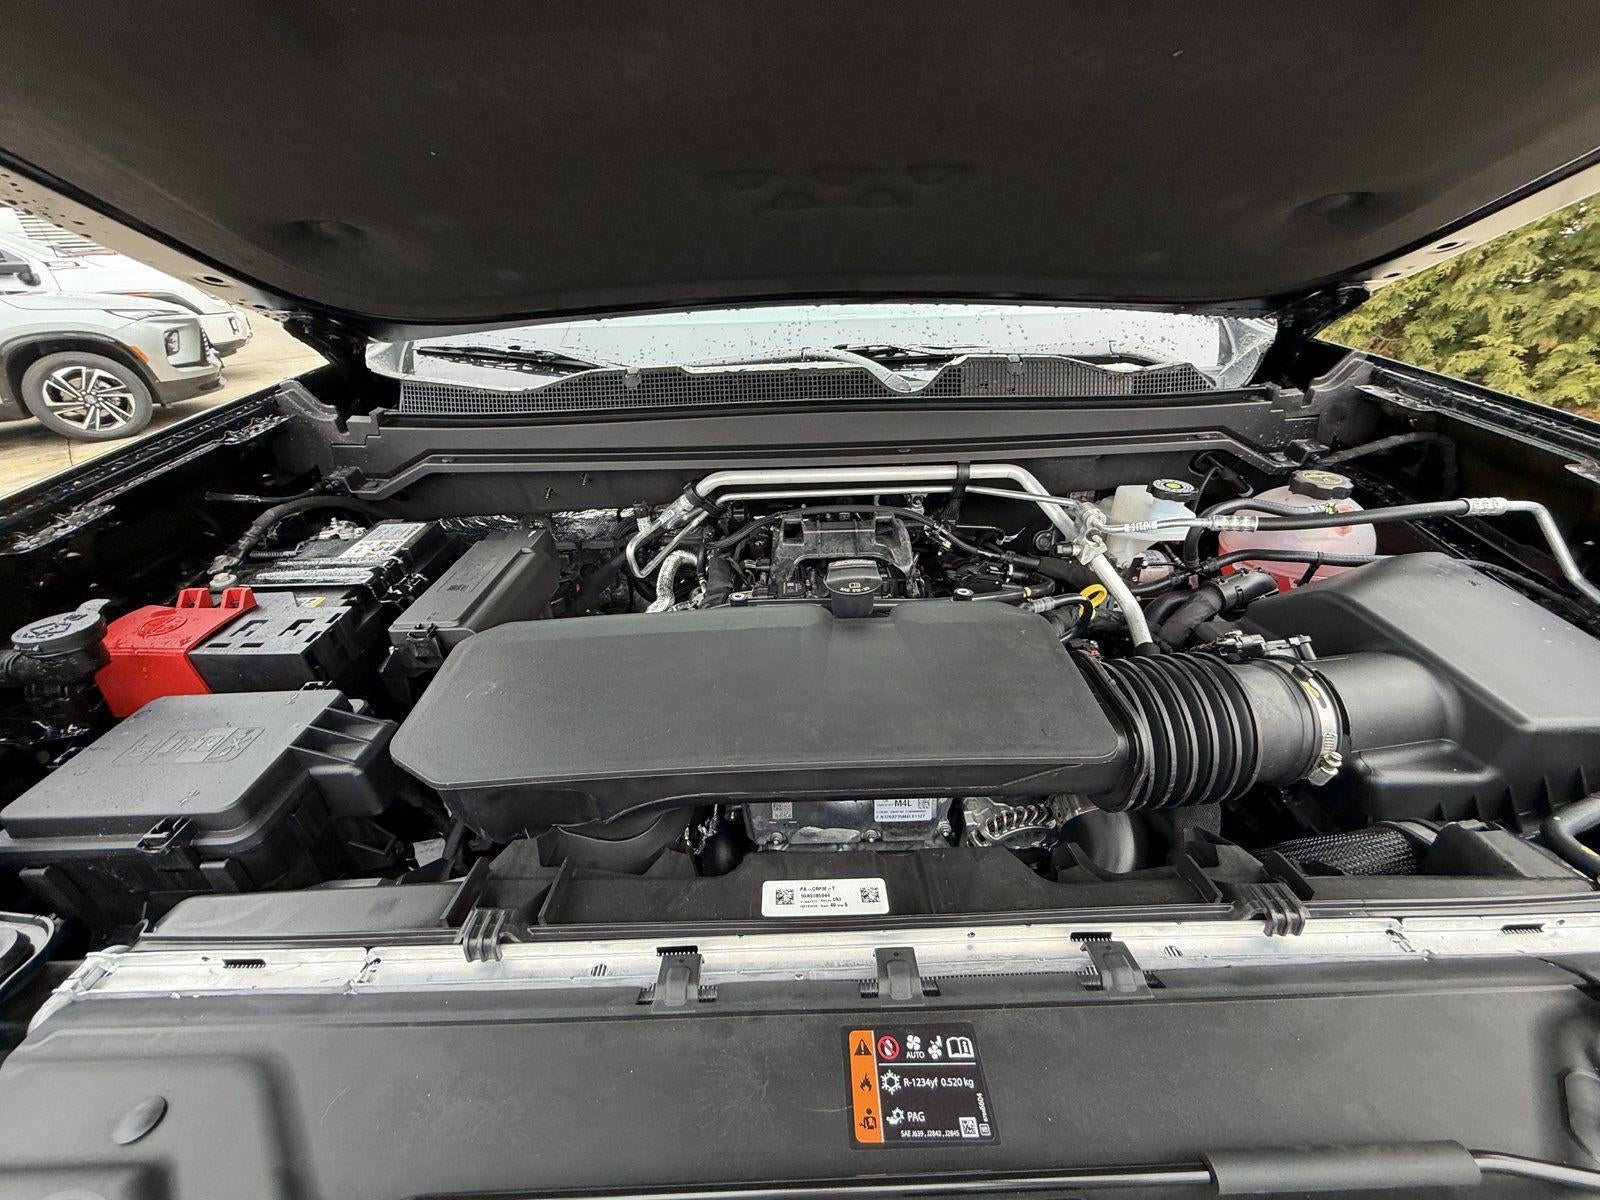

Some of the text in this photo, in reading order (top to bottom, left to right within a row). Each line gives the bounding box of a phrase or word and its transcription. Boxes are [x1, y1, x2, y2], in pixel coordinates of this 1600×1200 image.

[906, 1051, 925, 1059] AUTO
[903, 1077, 974, 1089] R-1234yf 0.520 kg
[907, 1111, 925, 1122] PAG
